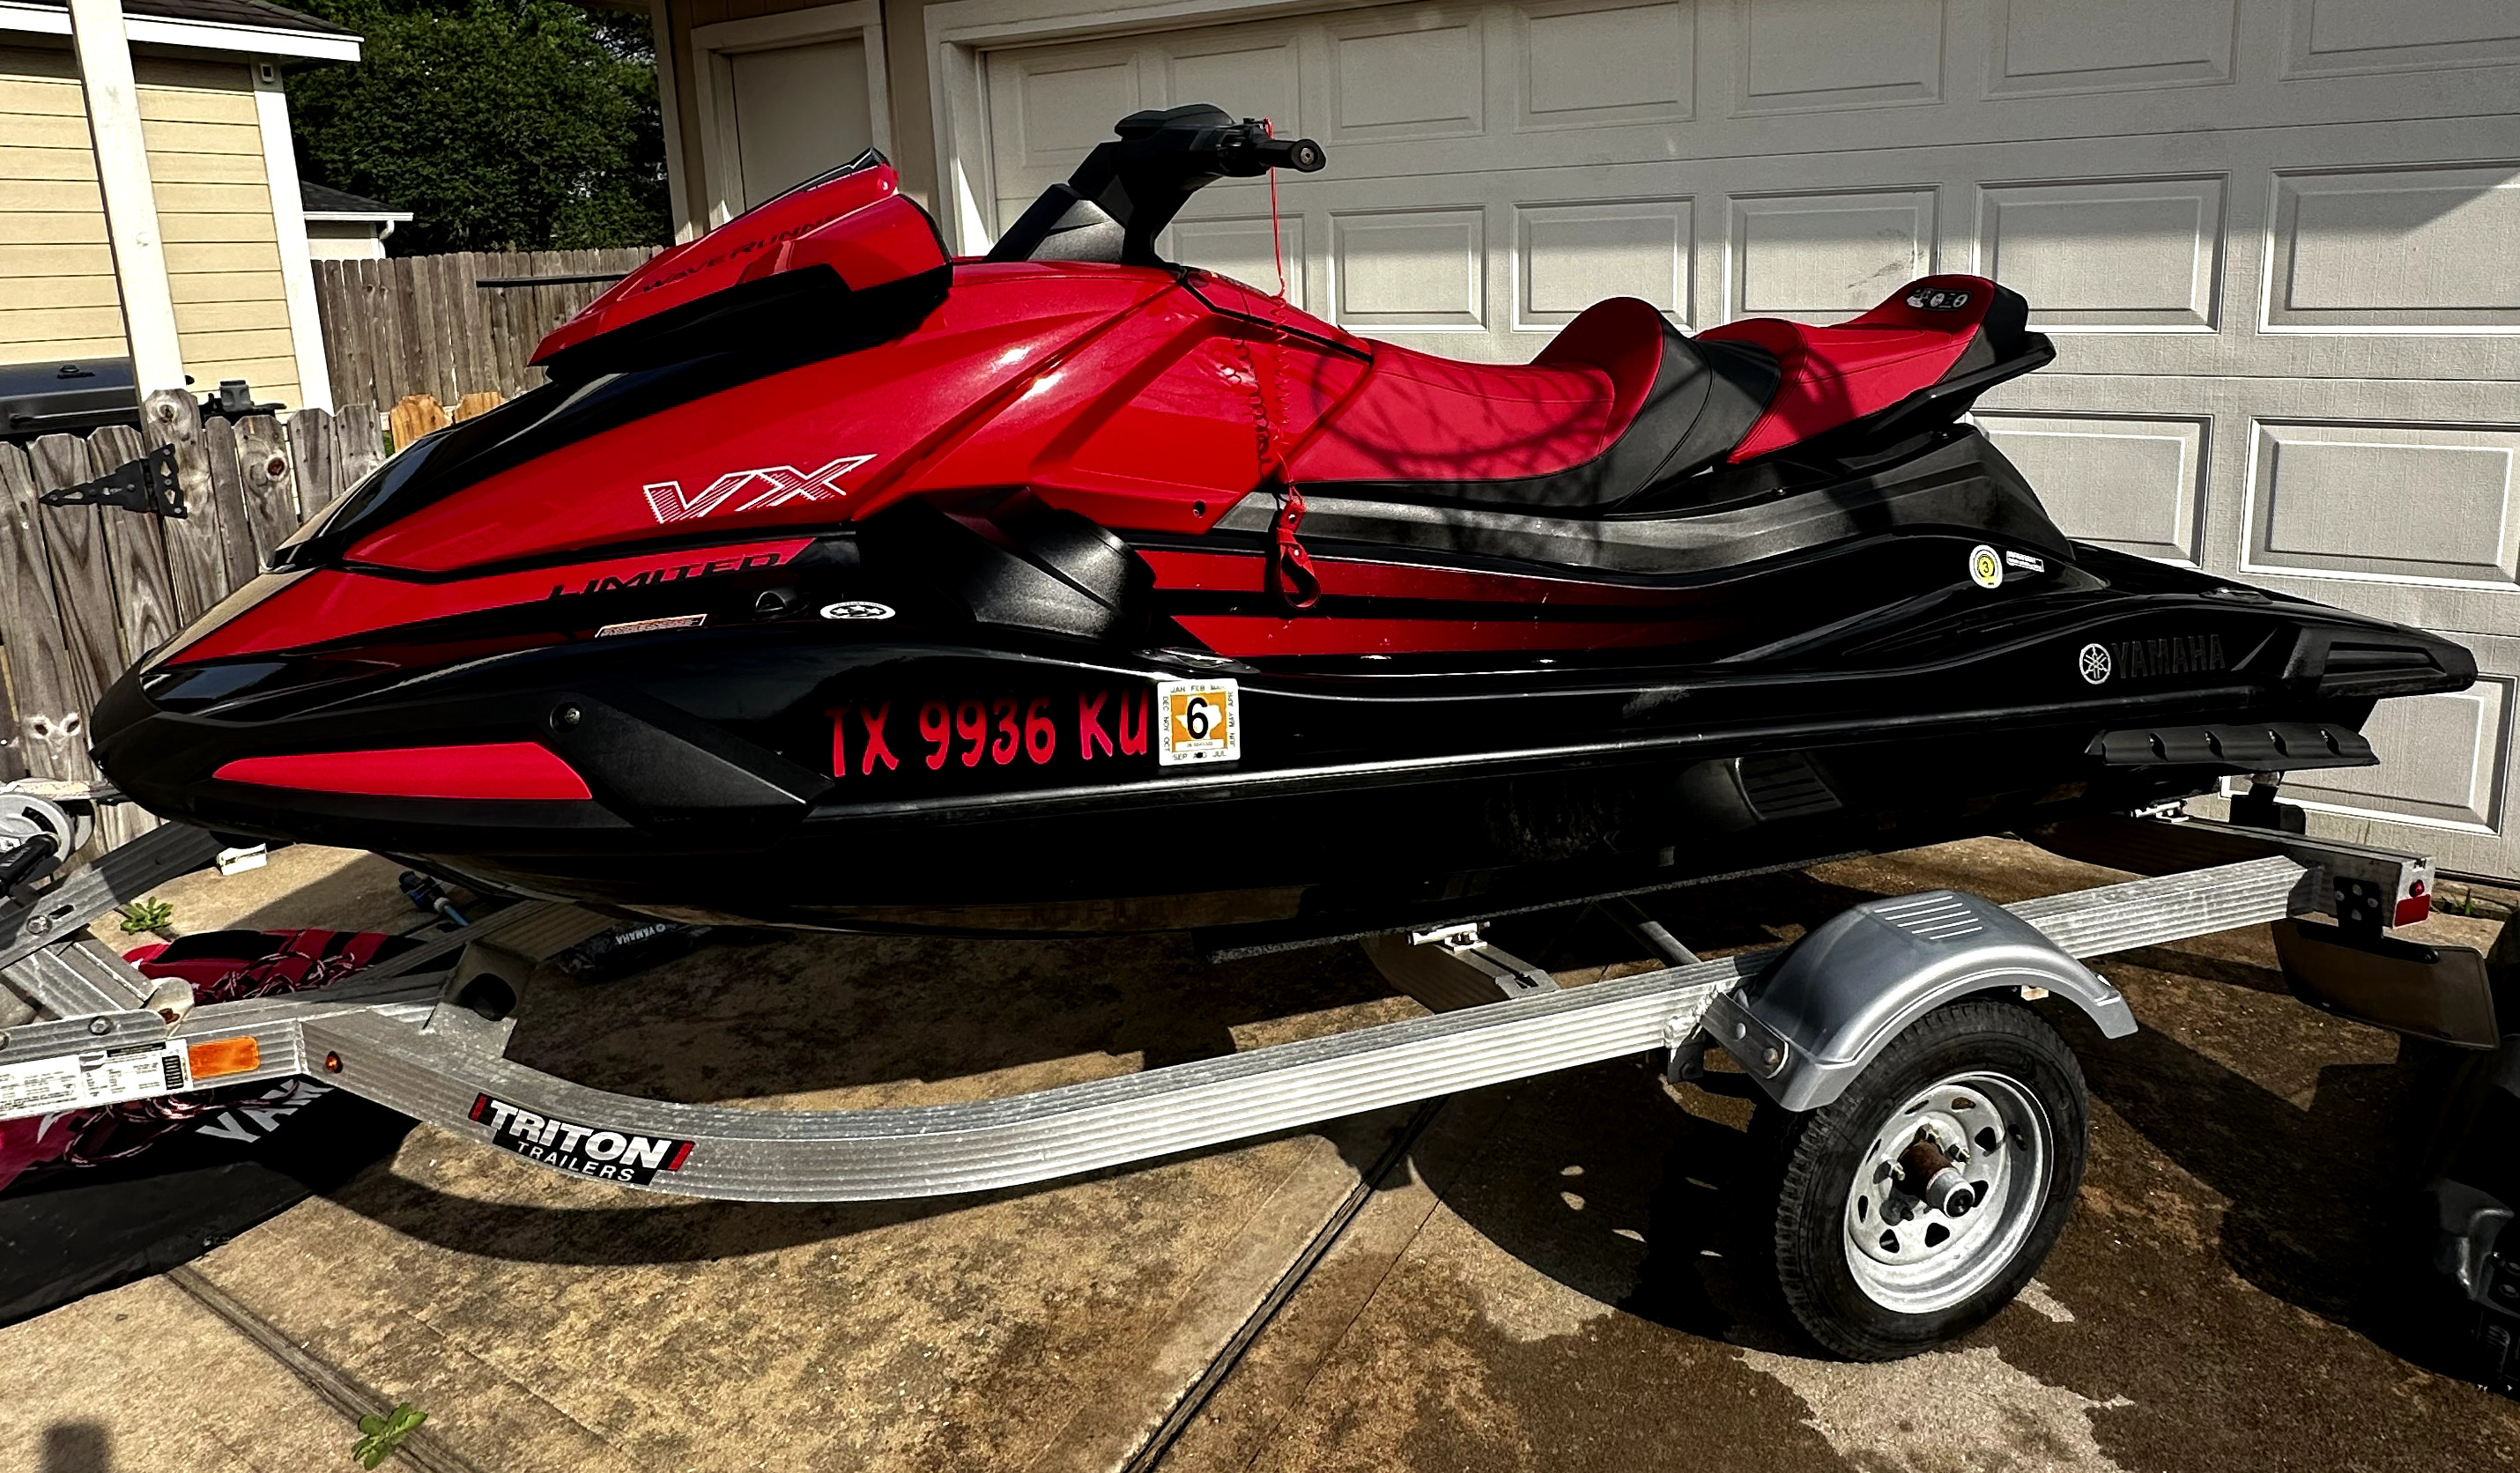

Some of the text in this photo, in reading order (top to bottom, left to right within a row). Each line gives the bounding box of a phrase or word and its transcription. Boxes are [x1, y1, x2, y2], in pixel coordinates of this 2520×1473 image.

[643, 453, 878, 524] VX
[546, 552, 782, 601] LIMITED
[2111, 633, 2227, 679] YAMAHA
[824, 686, 1150, 778] TX 9936 KU
[1187, 697, 1209, 740] 6
[1172, 752, 1188, 761] SEP
[615, 925, 656, 946] YAMAHA
[490, 1099, 672, 1169] TRITON
[517, 1140, 635, 1182] TRAILERS
